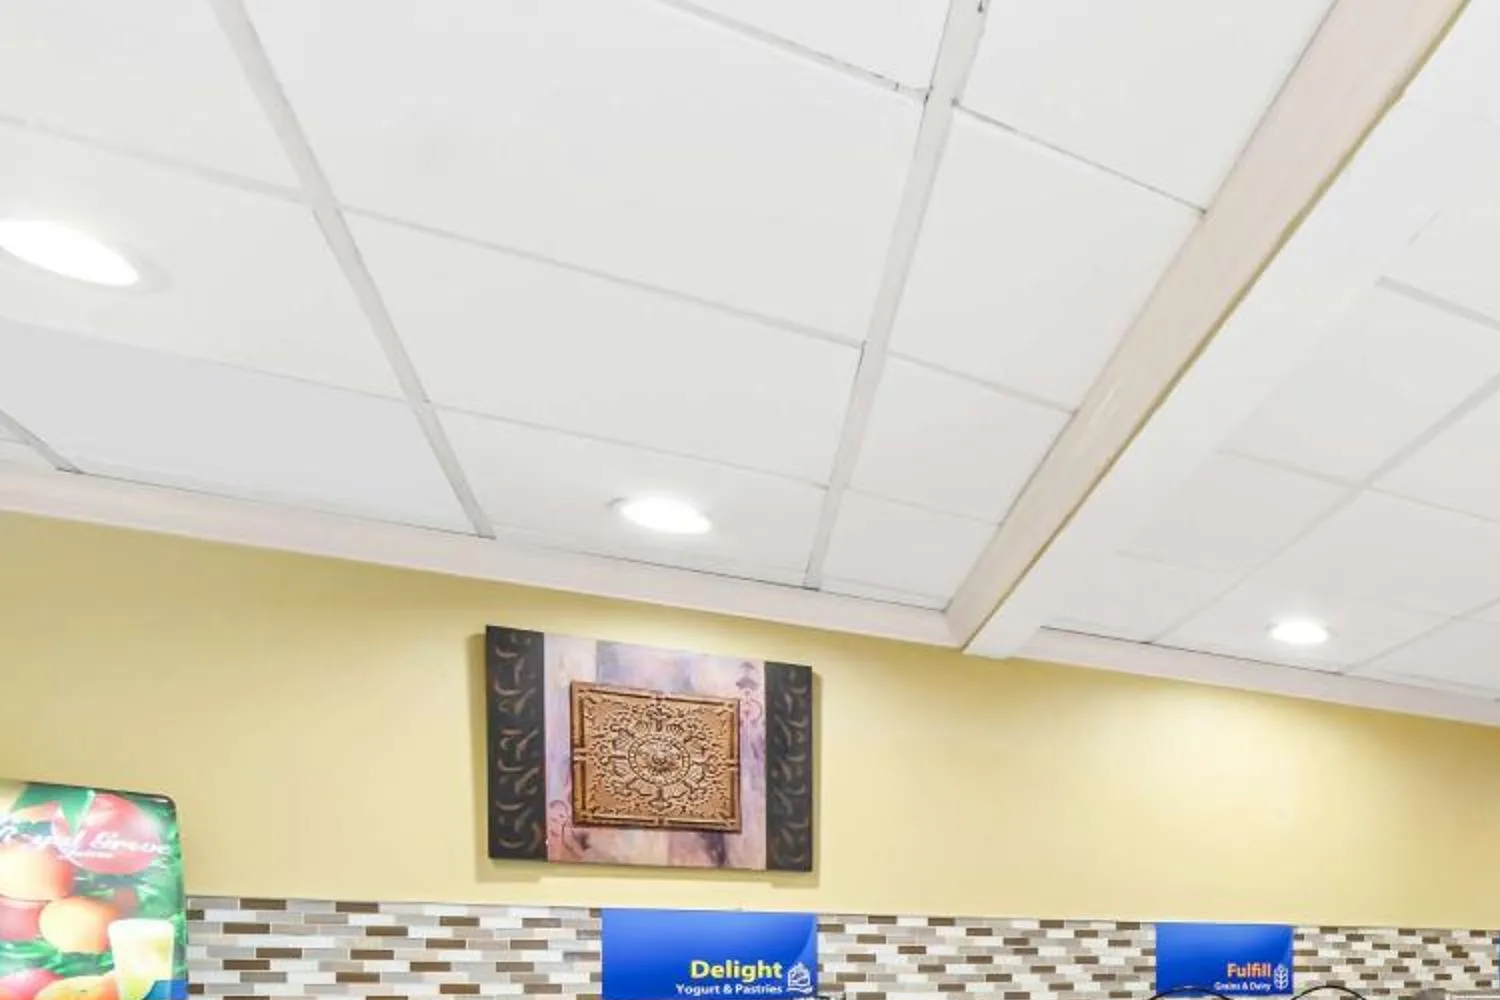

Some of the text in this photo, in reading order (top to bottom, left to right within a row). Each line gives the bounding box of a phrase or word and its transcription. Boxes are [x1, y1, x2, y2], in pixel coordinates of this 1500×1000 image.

[690, 960, 783, 982] Delight
[1227, 962, 1272, 977] Fulfill
[675, 983, 783, 996] Yogurt & Pastries
